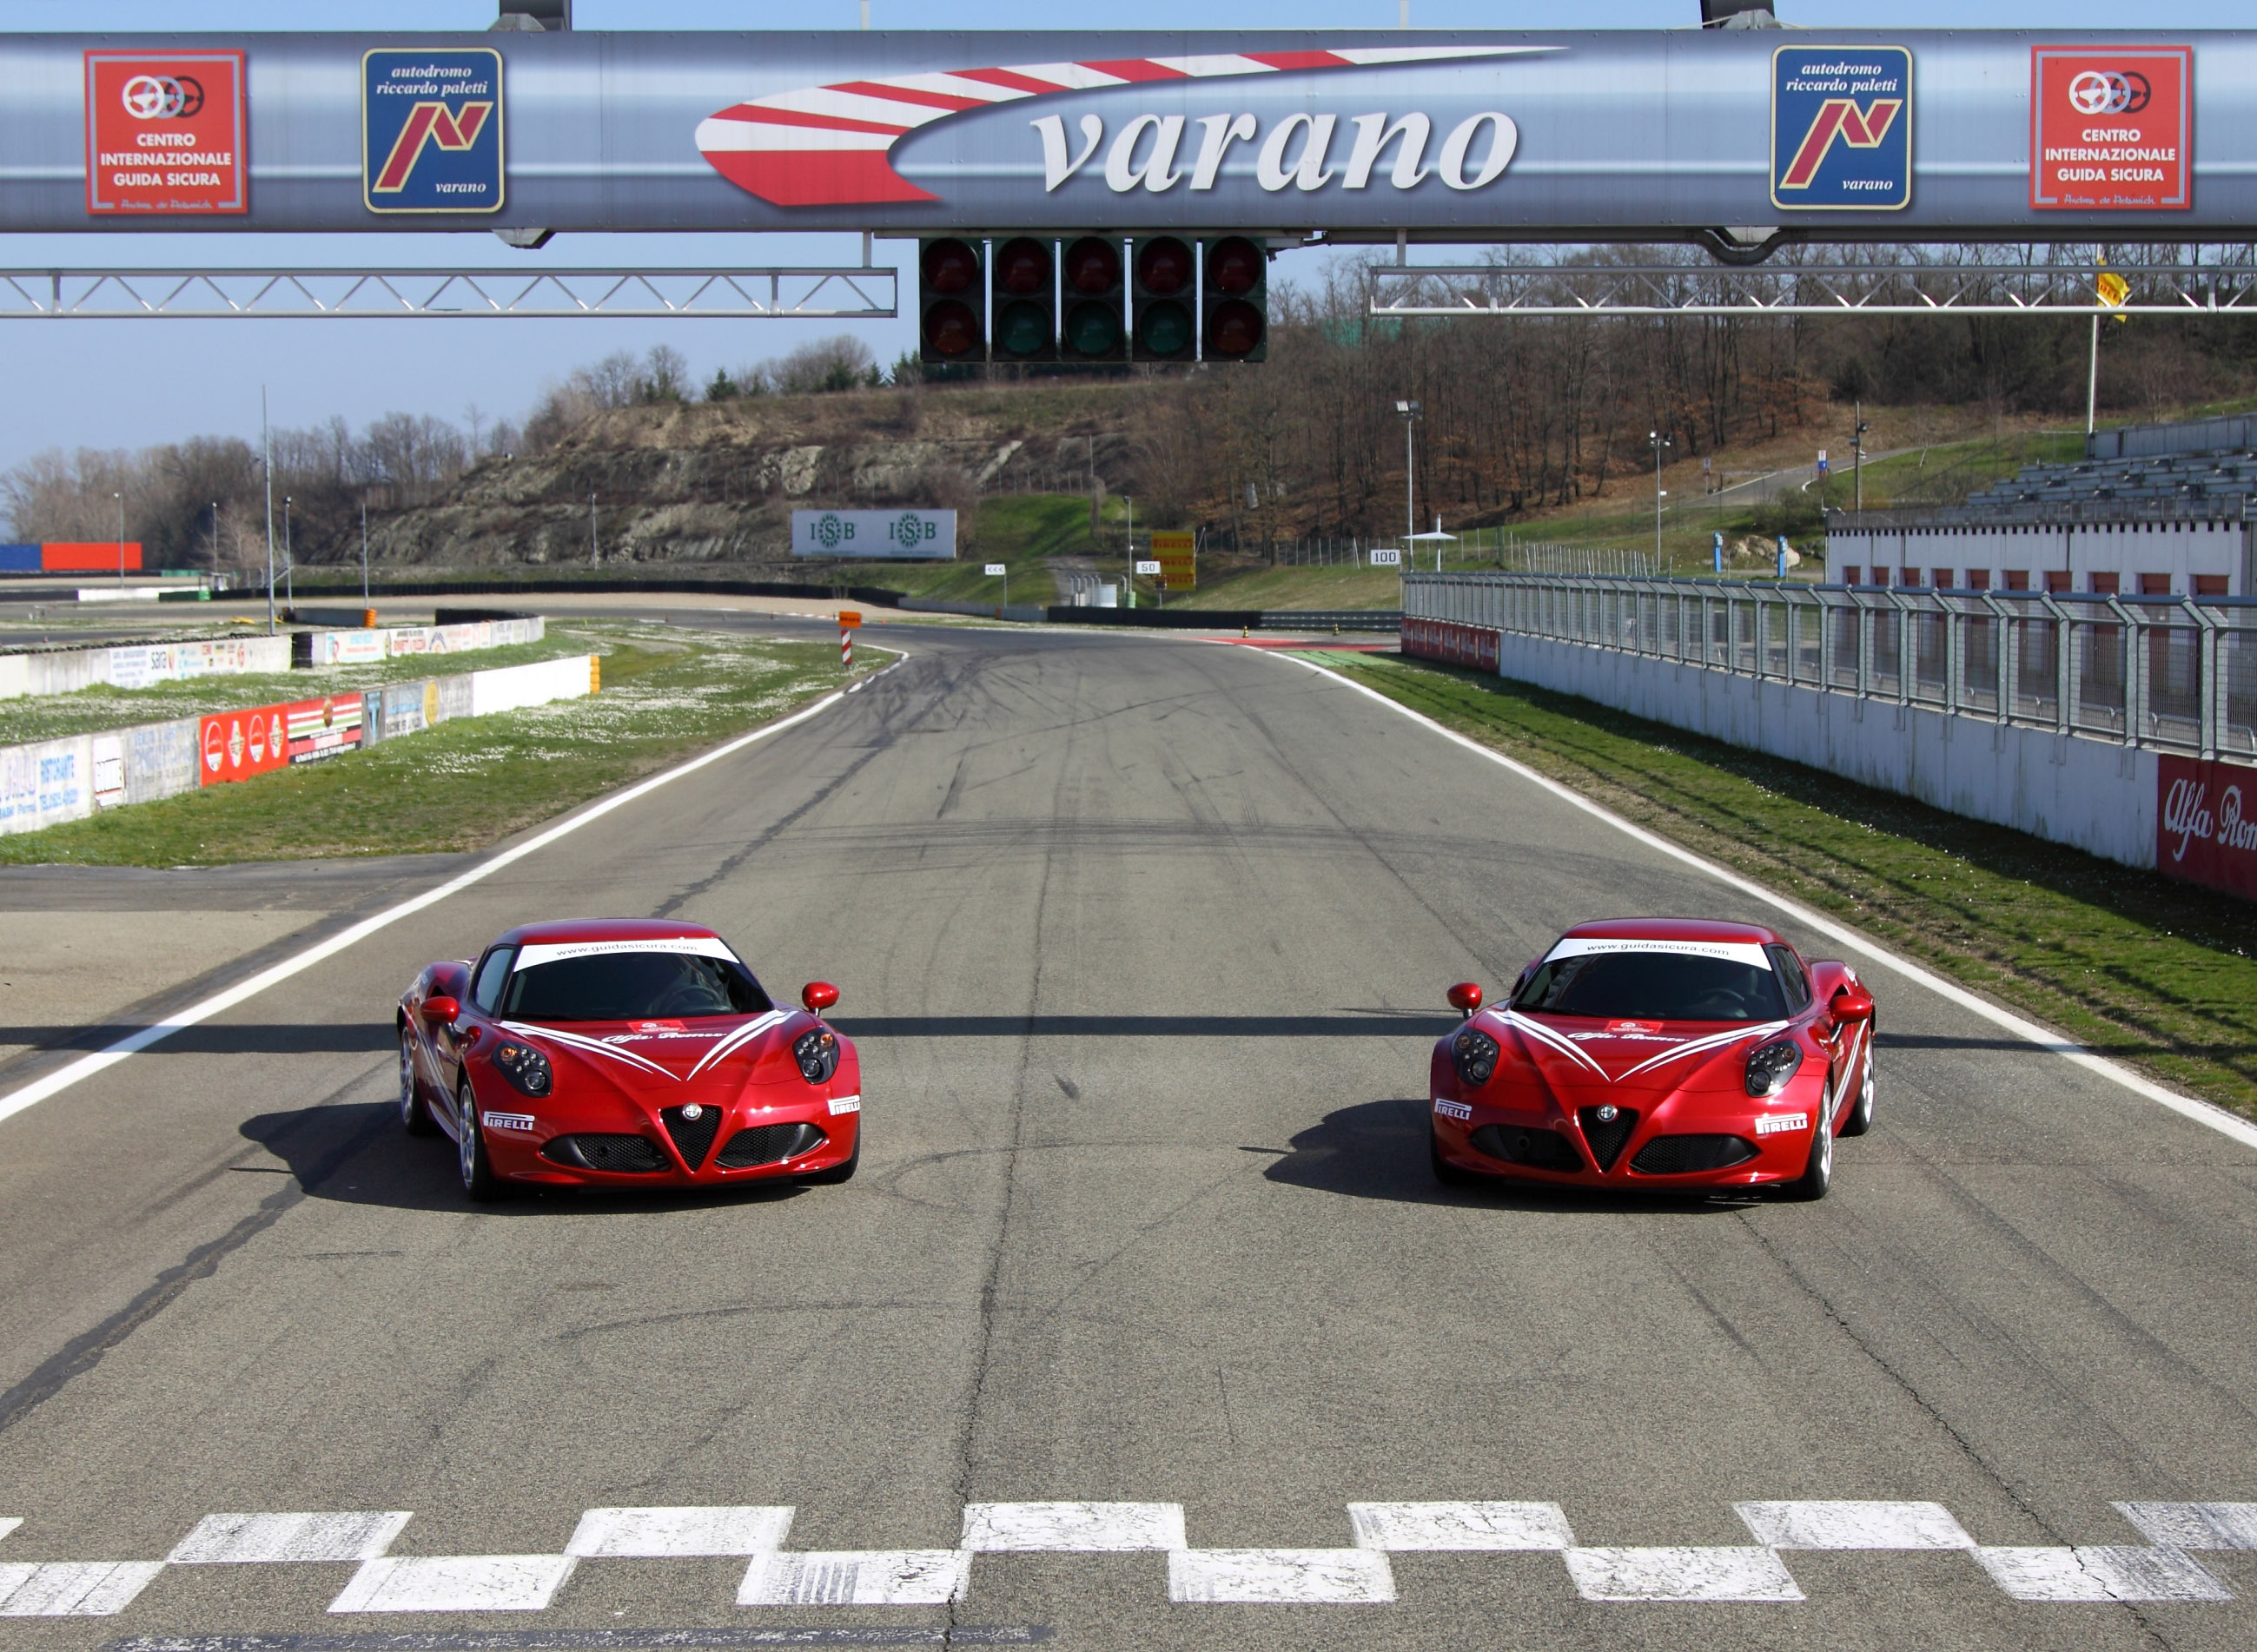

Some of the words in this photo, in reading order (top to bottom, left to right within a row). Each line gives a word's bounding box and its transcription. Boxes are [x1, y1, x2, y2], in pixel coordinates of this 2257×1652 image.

[391, 64, 472, 78] autodromo
[1801, 62, 1882, 75] autodromo
[376, 81, 438, 95] riccardo
[440, 81, 488, 97] paletti
[1786, 78, 1847, 91] riccardo
[1850, 78, 1897, 94] paletti
[136, 133, 196, 147] CENTRO
[2082, 129, 2141, 142] CENTRO
[1029, 111, 1518, 193] varano
[2045, 149, 2175, 161] INTERNAZIONALE
[101, 153, 231, 166] INTERNAZIONALE
[113, 173, 162, 186] GUIDA
[167, 173, 221, 186] SICURA
[2057, 169, 2106, 182] GUIDA
[2110, 169, 2164, 182] SICURA
[435, 182, 486, 193] varano
[1842, 180, 1893, 190] varano
[1375, 552, 1396, 562] 100
[1142, 563, 1155, 572] 50
[2164, 778, 2214, 862] Alfa
[556, 943, 698, 956] www.guidasicura.com
[1587, 942, 1730, 955] www.guidasicura.com
[1434, 1098, 1473, 1120] PIRELLI
[484, 1111, 535, 1131] PIRELLI
[1755, 1112, 1808, 1134] PIRELLI
